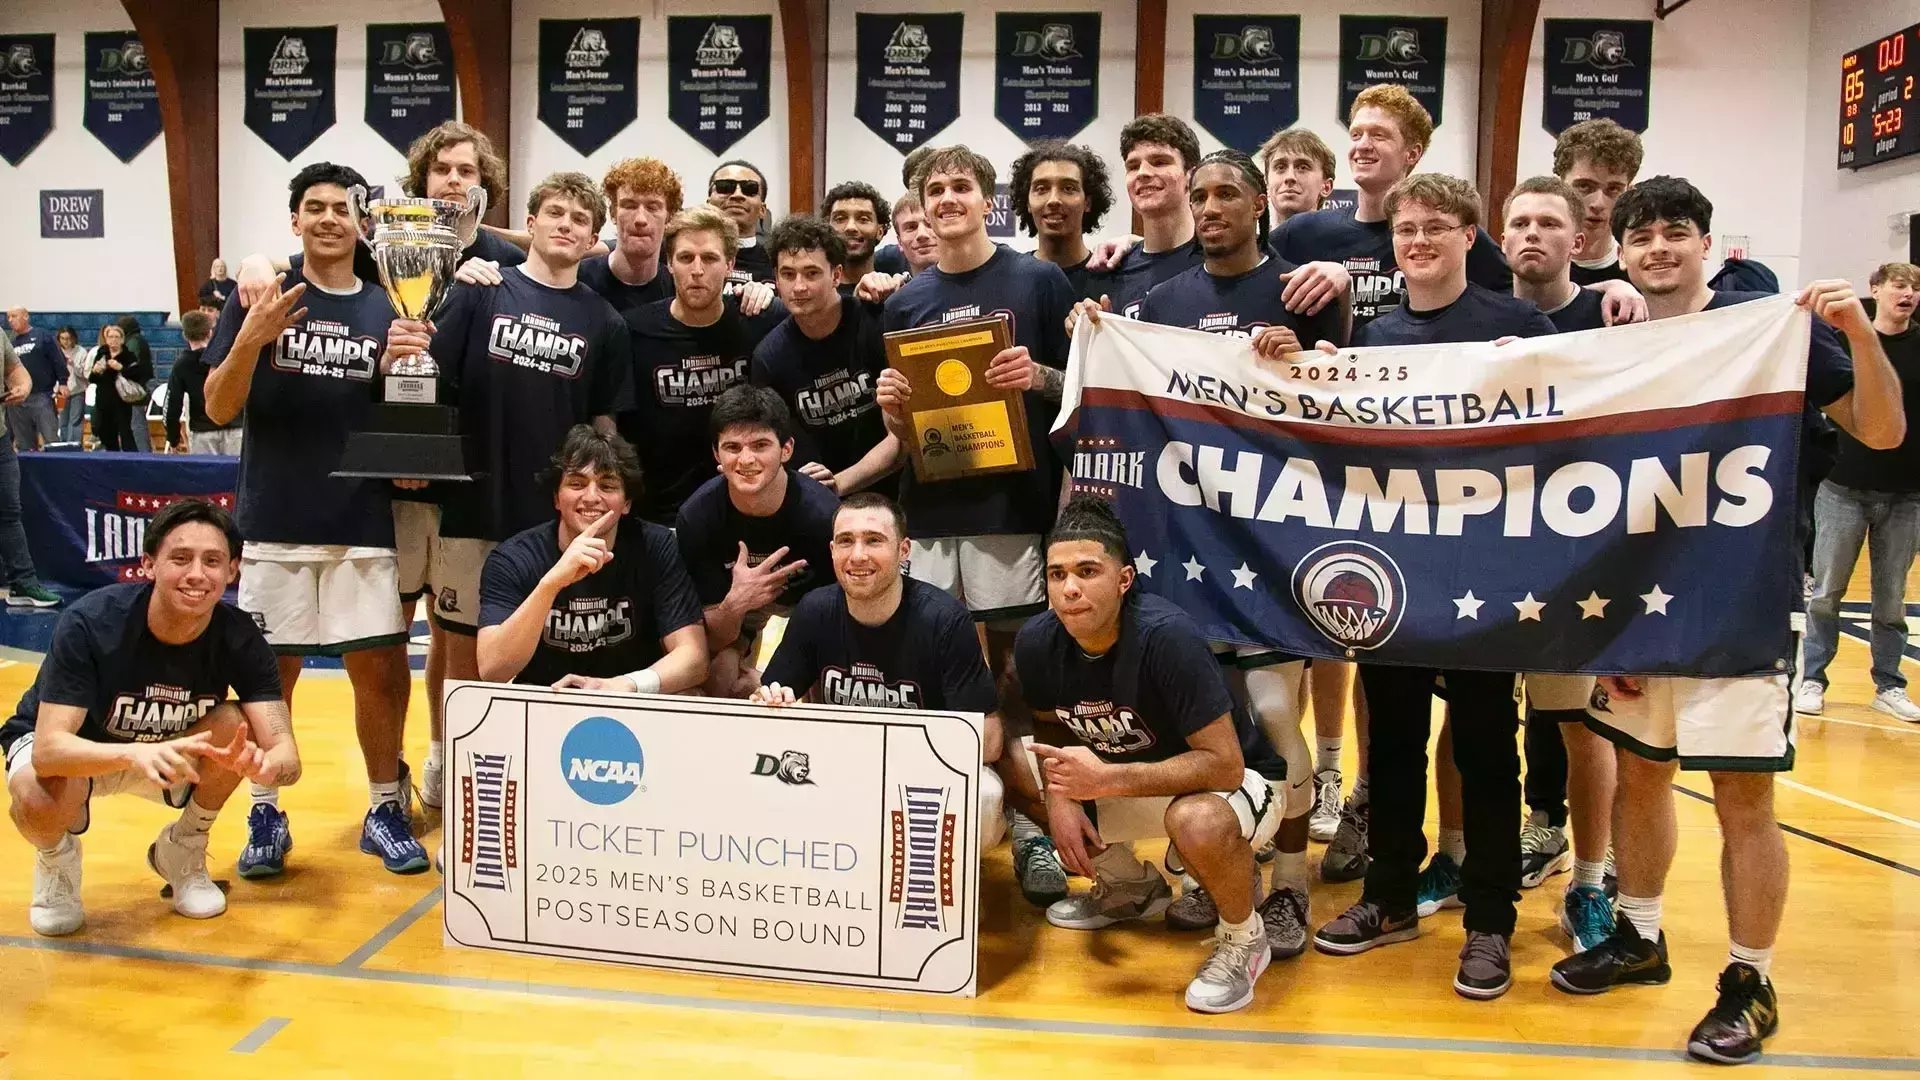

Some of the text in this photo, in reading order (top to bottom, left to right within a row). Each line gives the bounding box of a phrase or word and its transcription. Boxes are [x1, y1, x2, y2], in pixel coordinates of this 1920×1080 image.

[1879, 34, 1904, 72] 0.0
[383, 72, 439, 81] Women's Soccer
[691, 67, 747, 78] Women's Tennis
[884, 66, 931, 75] Men's Tennis
[1022, 65, 1072, 75] Men's Tennis
[1213, 67, 1280, 76] Men's Basketball
[1365, 69, 1419, 80] Women's Golf
[1575, 74, 1618, 83] Men's Golf
[1845, 68, 1865, 104] 85
[1878, 75, 1914, 109] period 2
[1223, 105, 1241, 114] 2021
[1573, 111, 1591, 120] 2022
[1843, 122, 1855, 146] 10
[1876, 138, 1897, 156] player
[49, 196, 93, 213] DREW
[52, 214, 89, 231] FANS
[521, 313, 560, 332] LANDMARK
[942, 306, 981, 324] LANDMARK
[1199, 314, 1239, 329] LANDMARK
[306, 321, 349, 337] LANDMARK
[275, 327, 378, 379] CHAMPS
[488, 317, 585, 376] CHAMPS
[302, 363, 345, 378] 2024-25
[512, 354, 552, 373] 2024-25
[682, 355, 721, 370] LANDMARK
[814, 367, 850, 390] LANDMARK
[1290, 366, 1409, 382] 2024-25
[798, 372, 876, 426] CHAMPS
[1166, 368, 1565, 426] MEN'S BASKETBALL
[951, 422, 974, 432] MEN'S
[954, 430, 996, 441] BASKETBALL
[956, 440, 1005, 453] CHAMPIONS
[1156, 443, 1774, 538] CHAMPIONS
[569, 598, 608, 611] LANDMARK
[544, 601, 632, 649] CHAMPS
[145, 686, 191, 702] LANDMARK
[568, 757, 641, 785] NCAA
[473, 752, 506, 891] LANDMARK
[508, 783, 516, 865] CONFERENCE
[547, 819, 858, 872] TICKET PUNCHED
[892, 814, 903, 899] CONFERENCE
[902, 785, 944, 932] LANDMARK
[536, 863, 873, 911] 2025 MEN'S BASKETBALL
[537, 897, 866, 948] POSTSEASON BOUND
